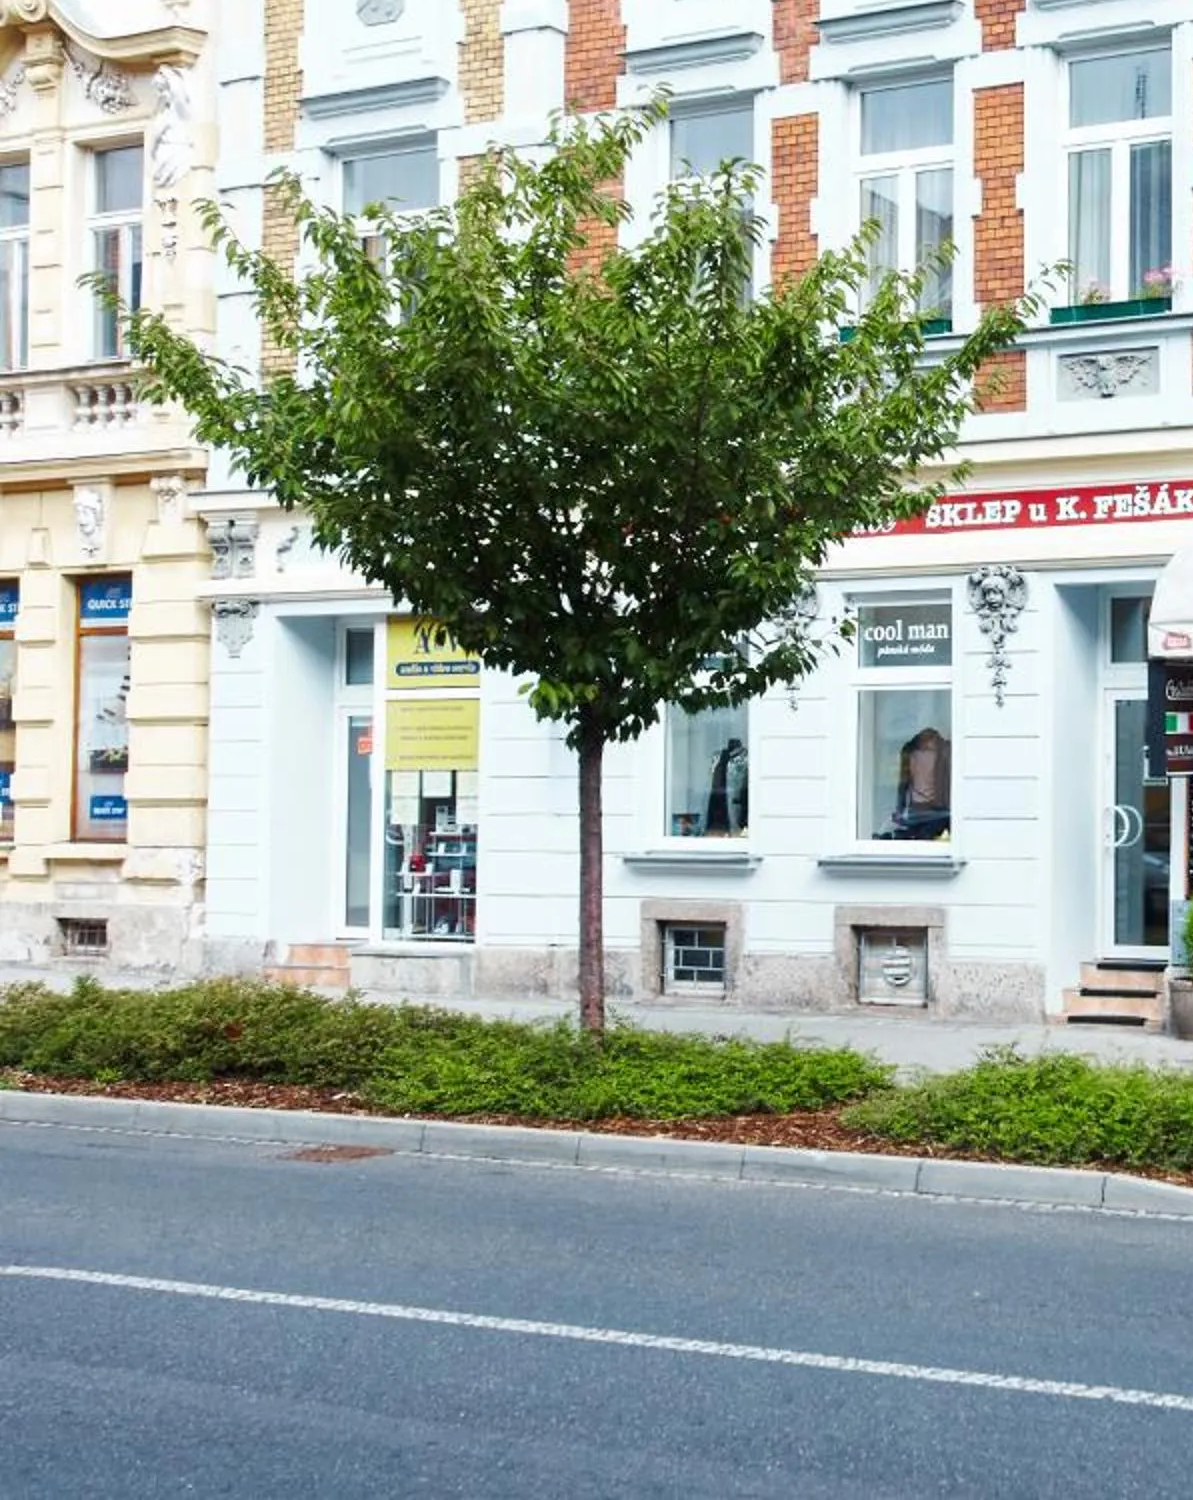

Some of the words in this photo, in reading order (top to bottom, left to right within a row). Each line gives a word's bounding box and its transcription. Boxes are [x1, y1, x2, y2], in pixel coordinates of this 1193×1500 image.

[925, 499, 1021, 529] SKLEP
[1028, 503, 1047, 522] u
[1055, 495, 1088, 520] K.
[865, 619, 903, 641] cool
[907, 622, 949, 640] man
